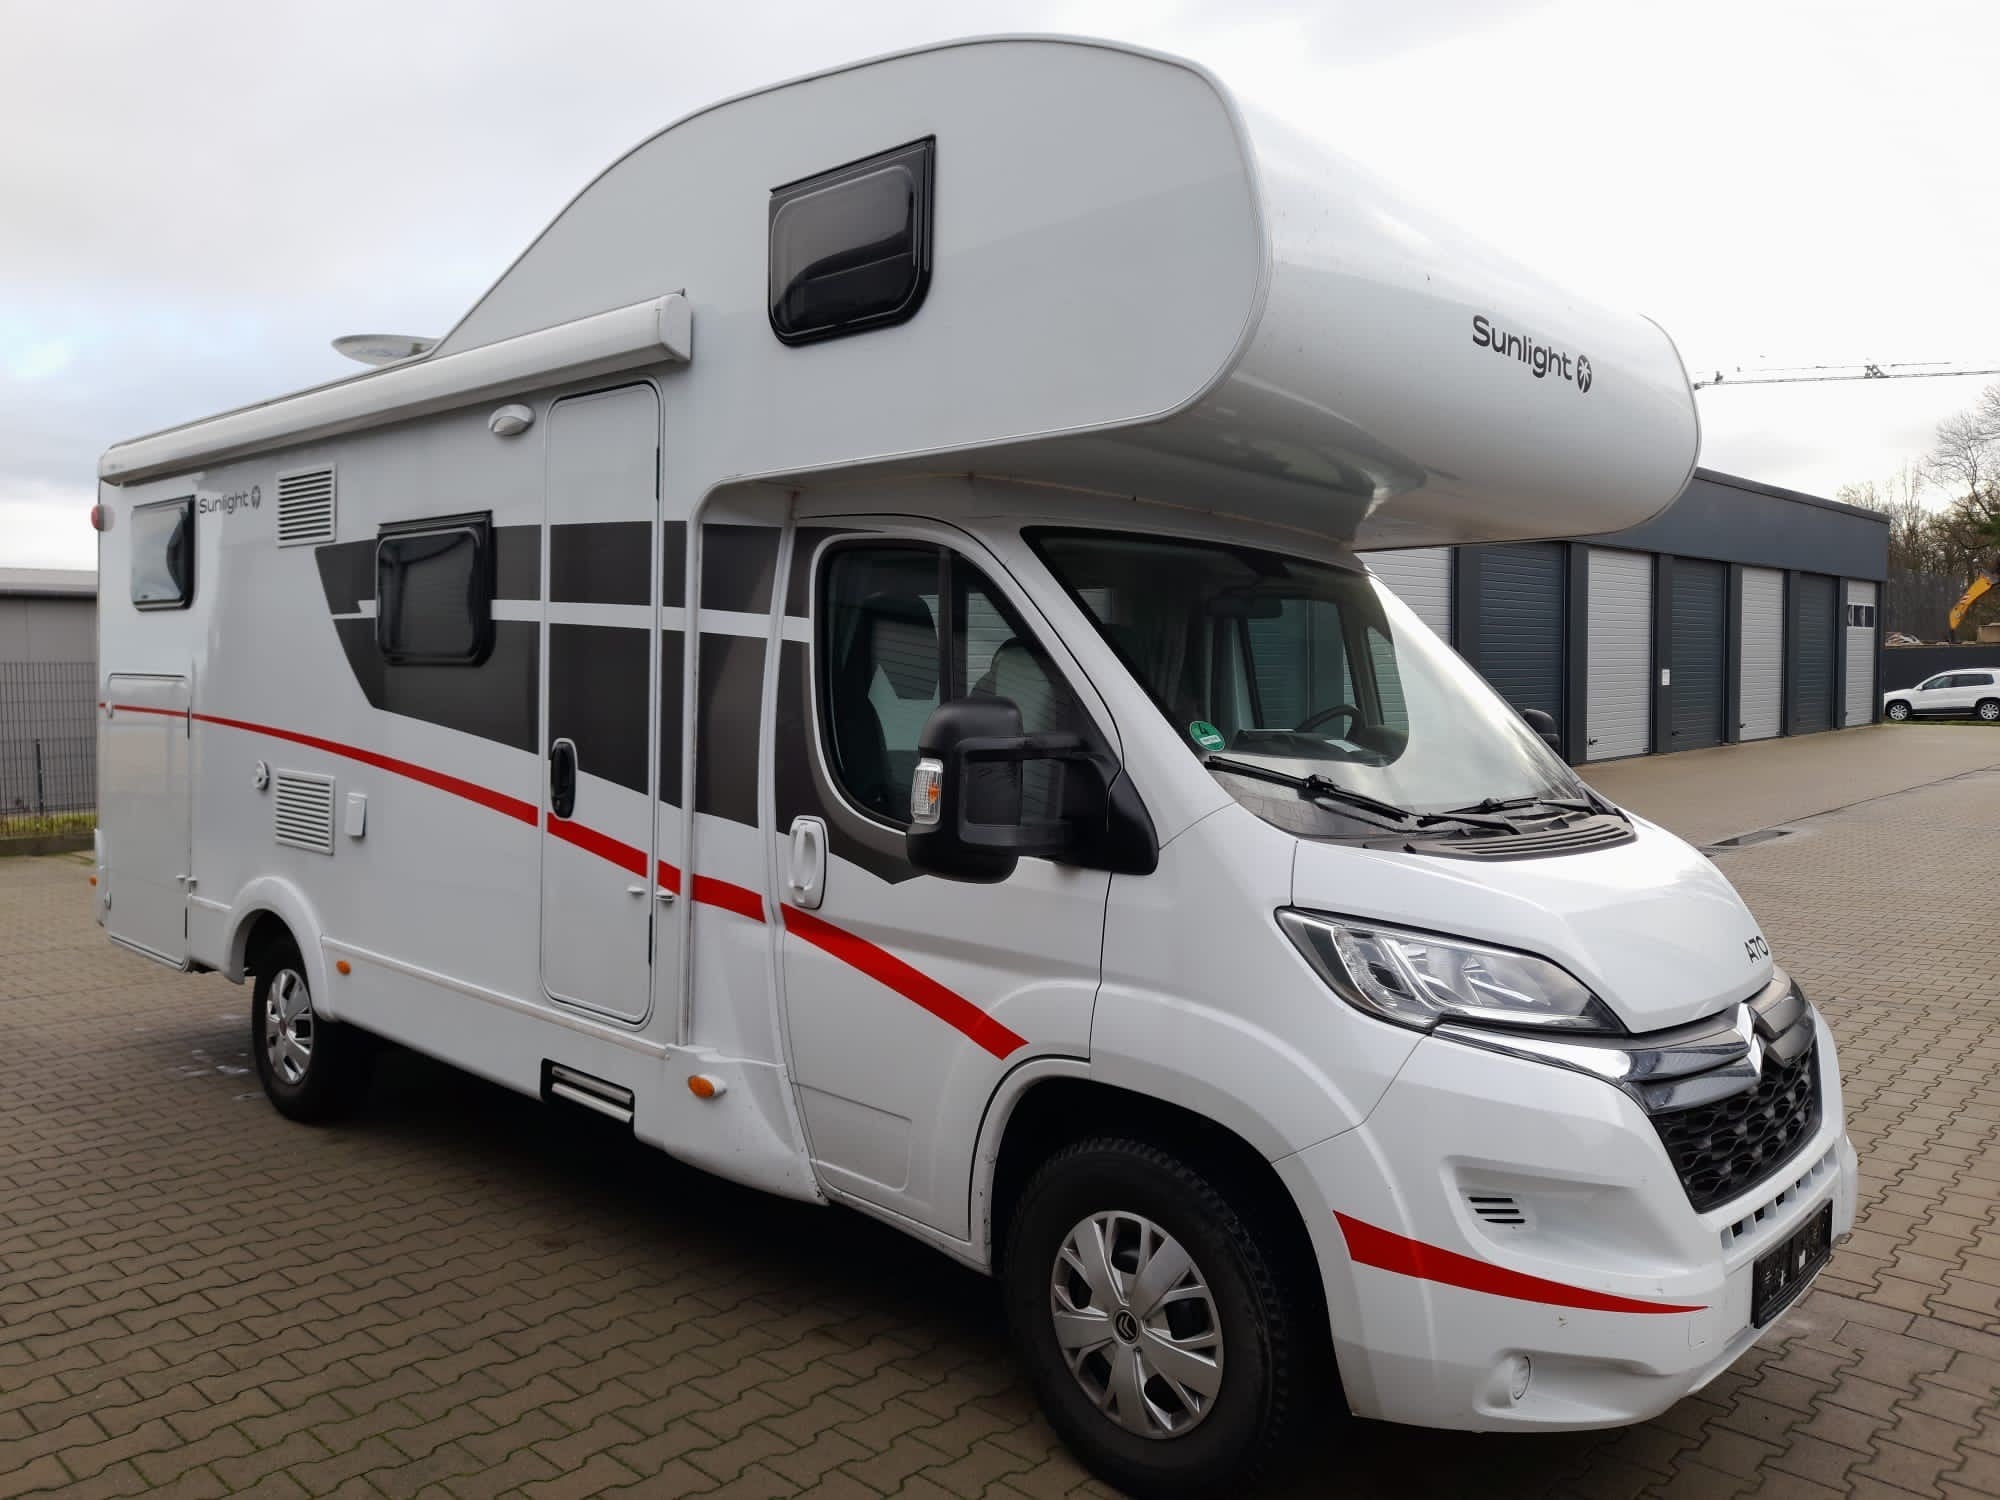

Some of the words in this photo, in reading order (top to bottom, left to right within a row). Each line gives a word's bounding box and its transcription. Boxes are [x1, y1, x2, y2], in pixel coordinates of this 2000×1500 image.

[1472, 314, 1573, 380] Sunlight
[199, 490, 249, 515] Sunlight
[1198, 723, 1210, 736] 4
